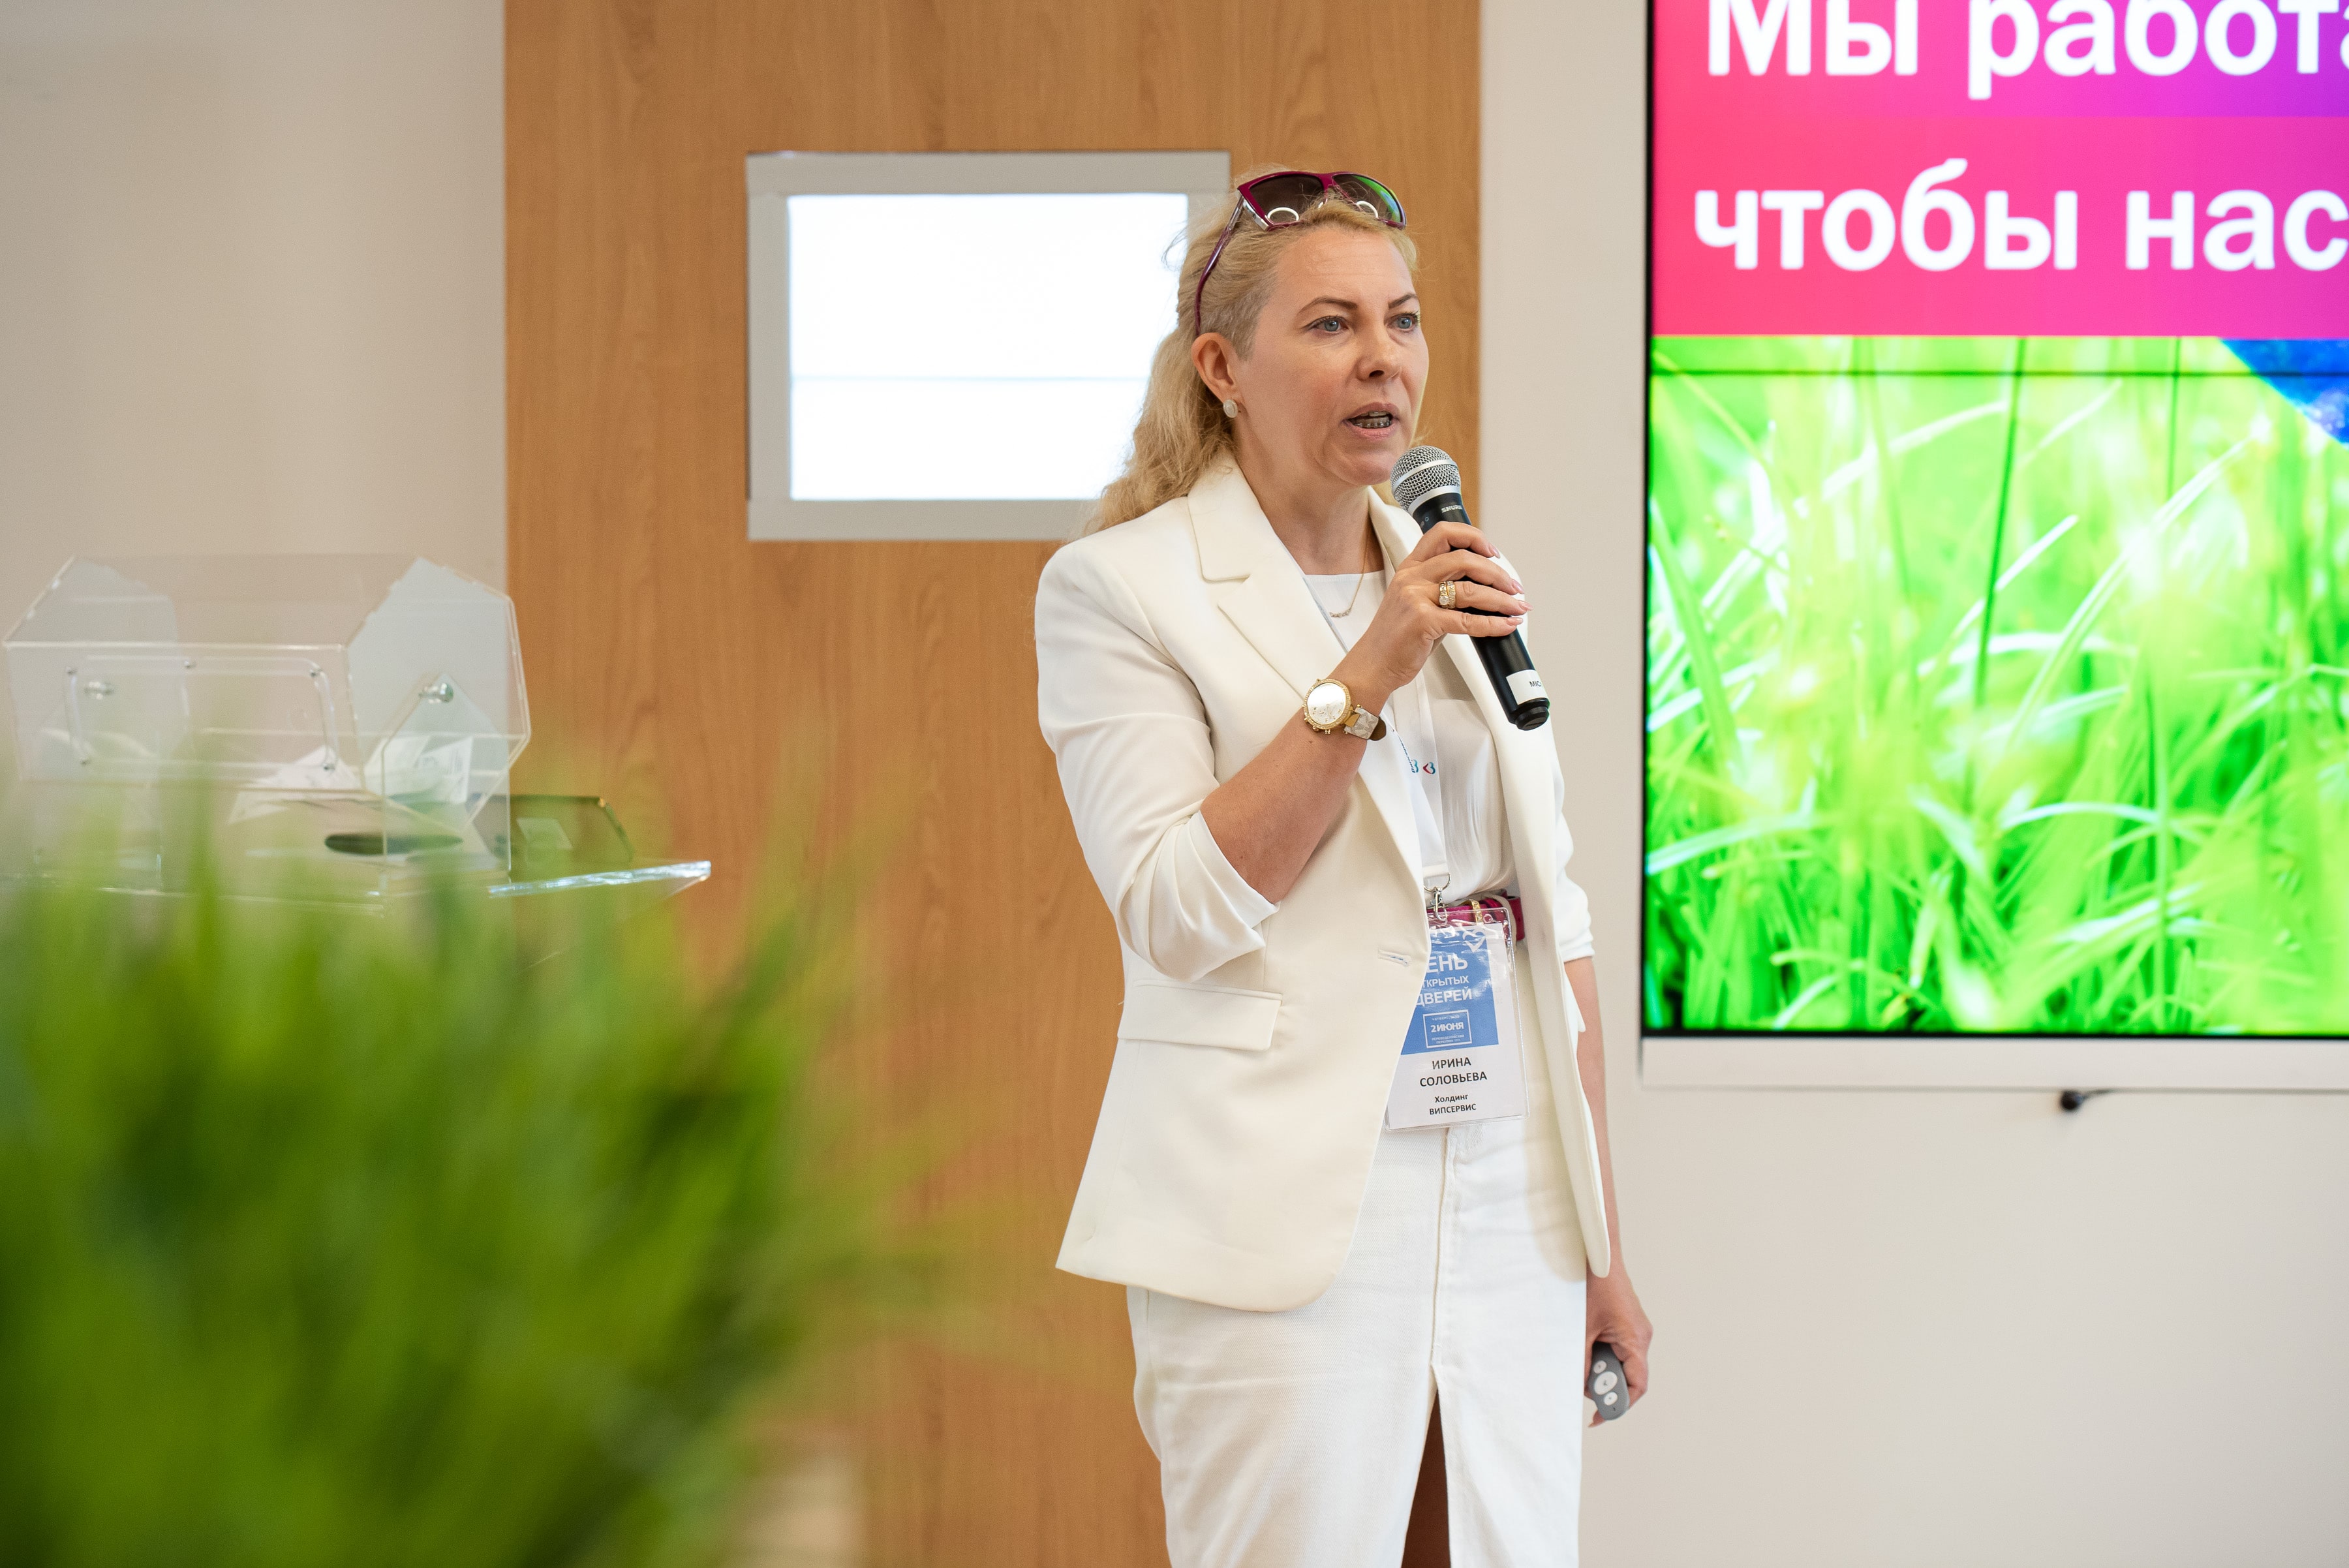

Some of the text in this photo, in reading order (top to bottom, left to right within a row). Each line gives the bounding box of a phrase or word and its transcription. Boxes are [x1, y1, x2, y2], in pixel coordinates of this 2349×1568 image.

[1707, 0, 2349, 101] Мы работ
[1695, 157, 2349, 271] чтобы нас
[1441, 504, 1463, 514] SHURE
[1426, 953, 1469, 974] ЕНЬ
[1422, 975, 1470, 989] ТКРЫТЫХ
[1416, 985, 1473, 1007] ДВЕРЕЙ
[1432, 1056, 1472, 1070] ИРИНА
[1419, 1071, 1488, 1087] СОЛОВЬЕВА
[1434, 1094, 1469, 1103] Холдинг
[1429, 1103, 1477, 1115] ВИПСЕРВИС
